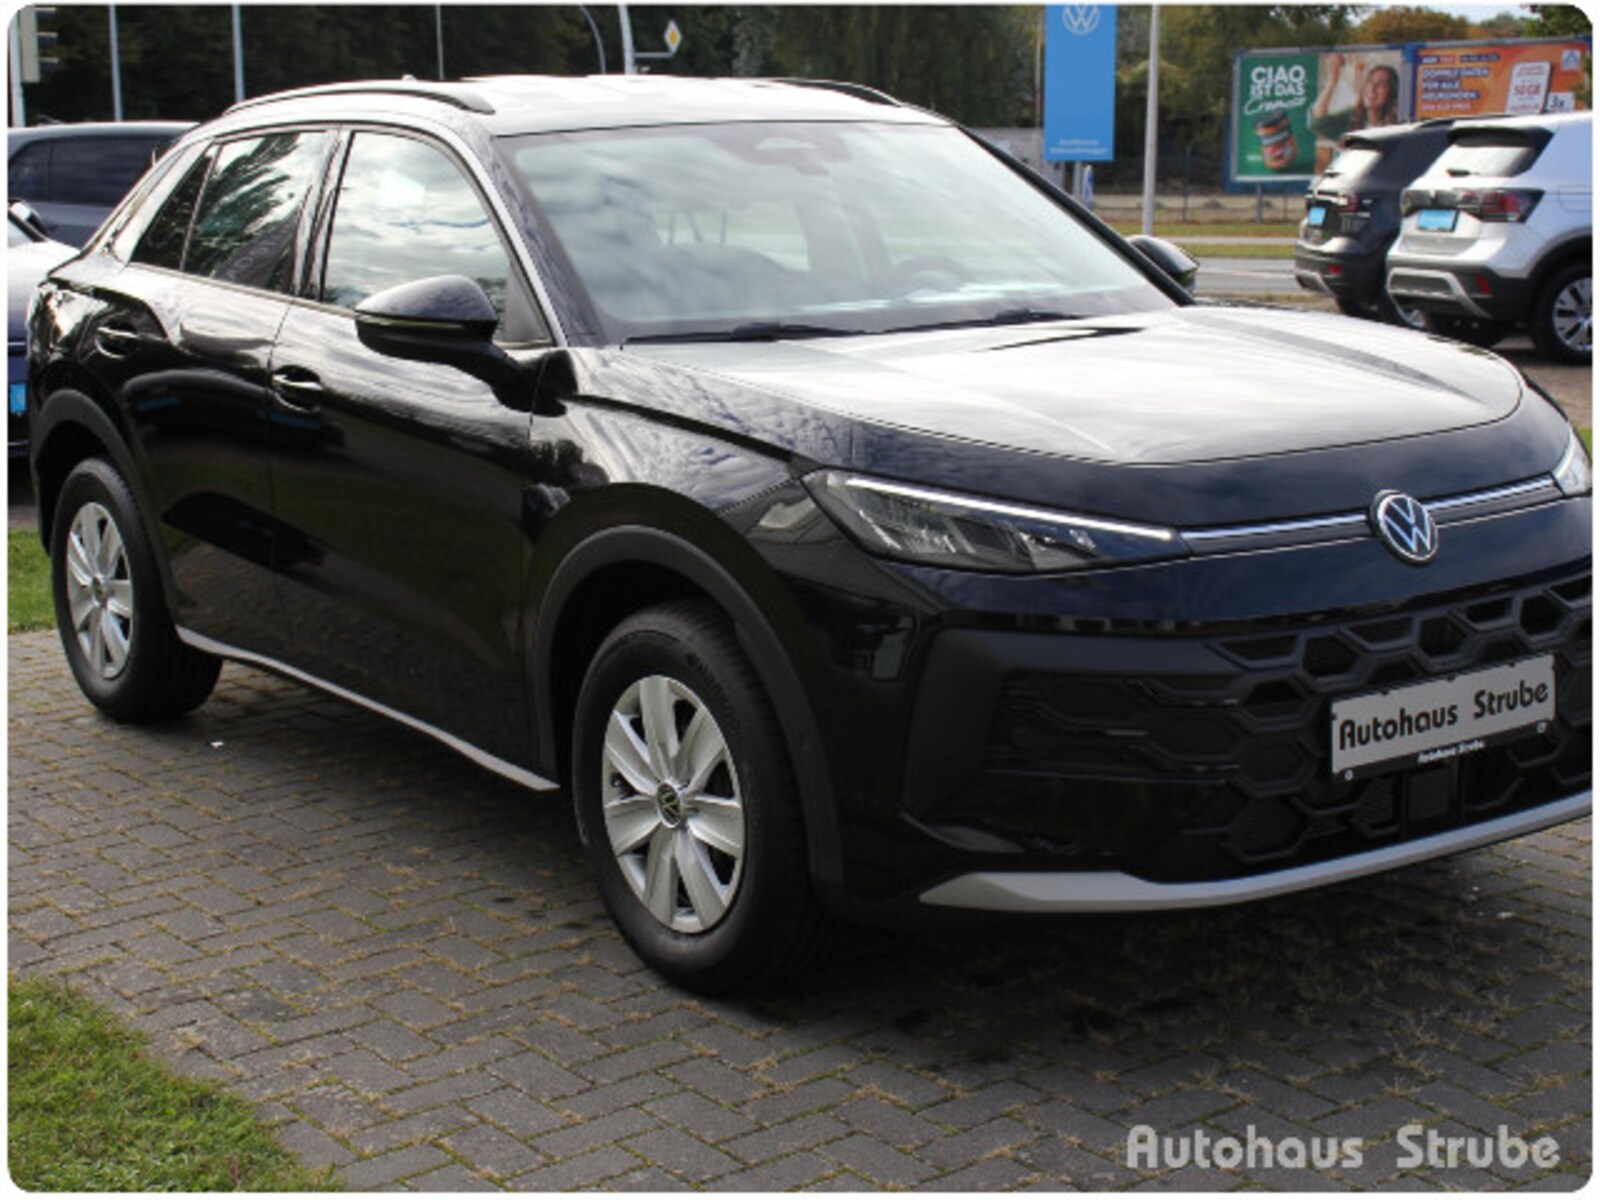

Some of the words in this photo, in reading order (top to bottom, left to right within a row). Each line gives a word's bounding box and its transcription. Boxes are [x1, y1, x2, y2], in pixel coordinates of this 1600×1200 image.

[1274, 81, 1306, 97] DAS
[1339, 707, 1458, 750] Autohaus
[1473, 680, 1549, 719] Strube
